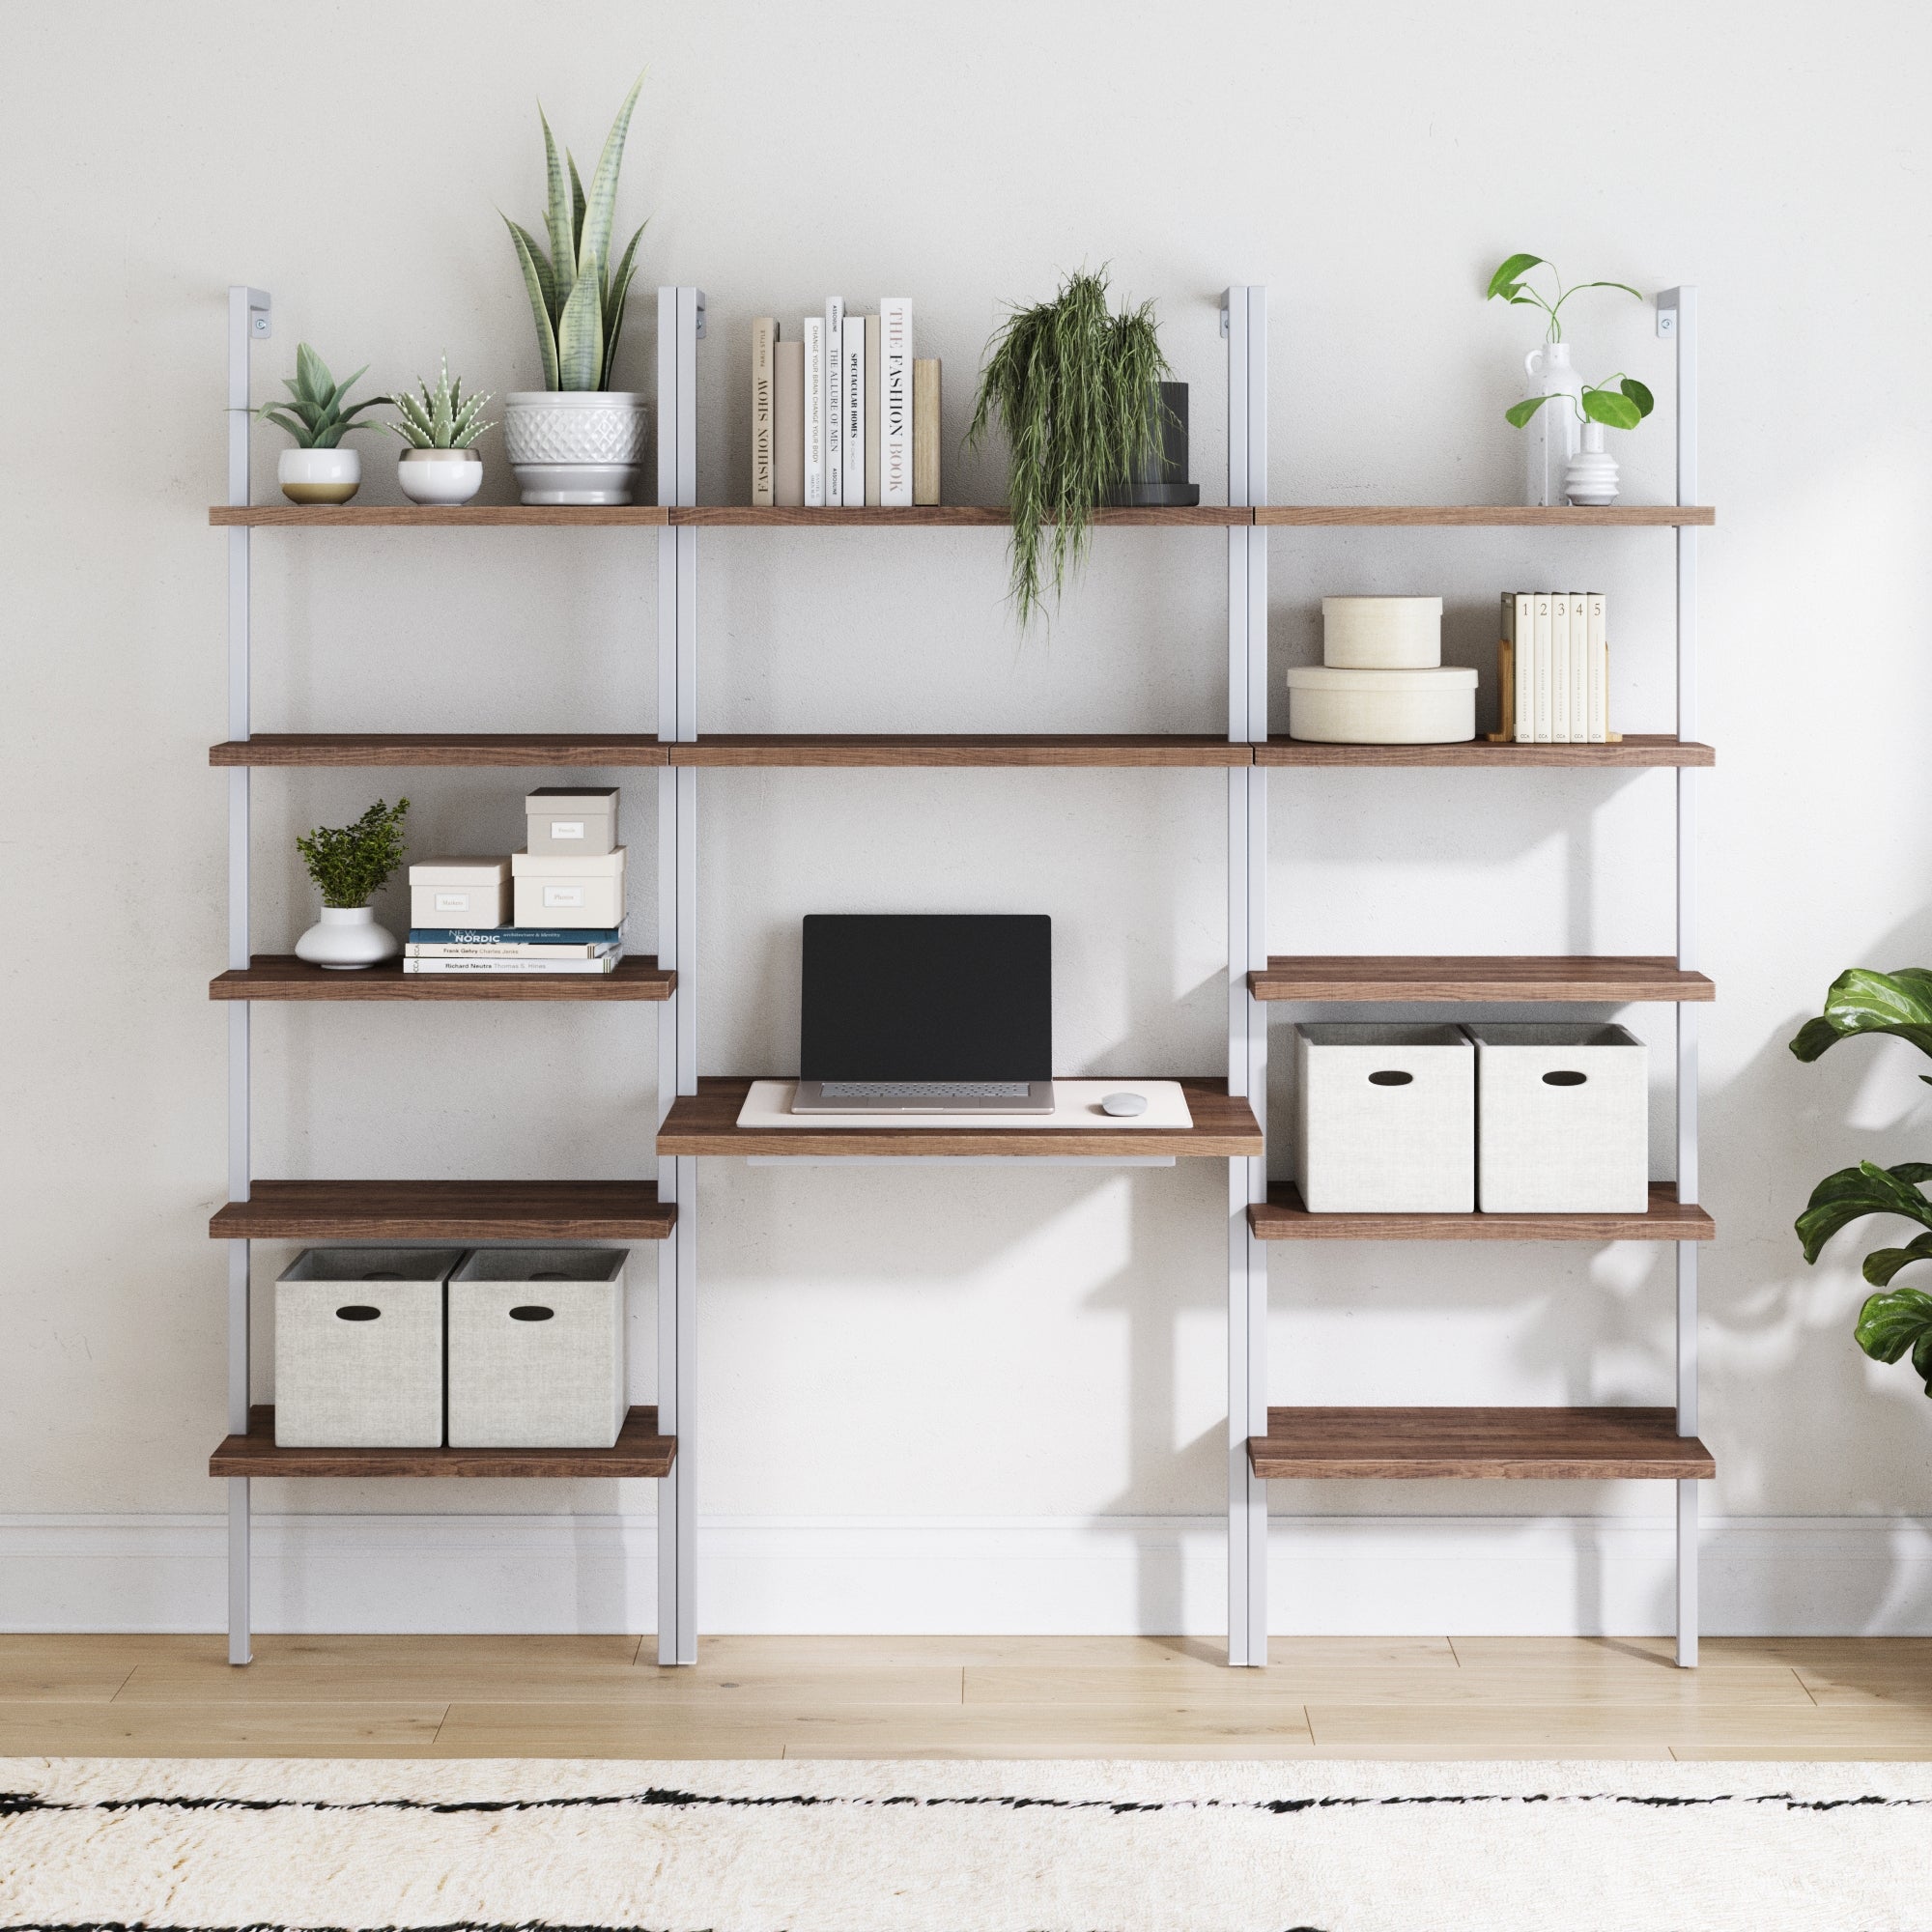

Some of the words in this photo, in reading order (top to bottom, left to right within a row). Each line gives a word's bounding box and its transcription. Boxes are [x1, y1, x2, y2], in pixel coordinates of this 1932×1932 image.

[889, 308, 903, 348] THE
[758, 378, 769, 421] SHOW
[889, 355, 903, 437] FASHION
[830, 413, 838, 428] OF
[758, 428, 769, 492] FASHION
[889, 443, 903, 492] BOOK
[1524, 603, 1527, 616] 1
[1540, 603, 1547, 616] 2
[1558, 603, 1565, 616] 3
[1576, 603, 1583, 616] 4
[1594, 603, 1600, 616] 5
